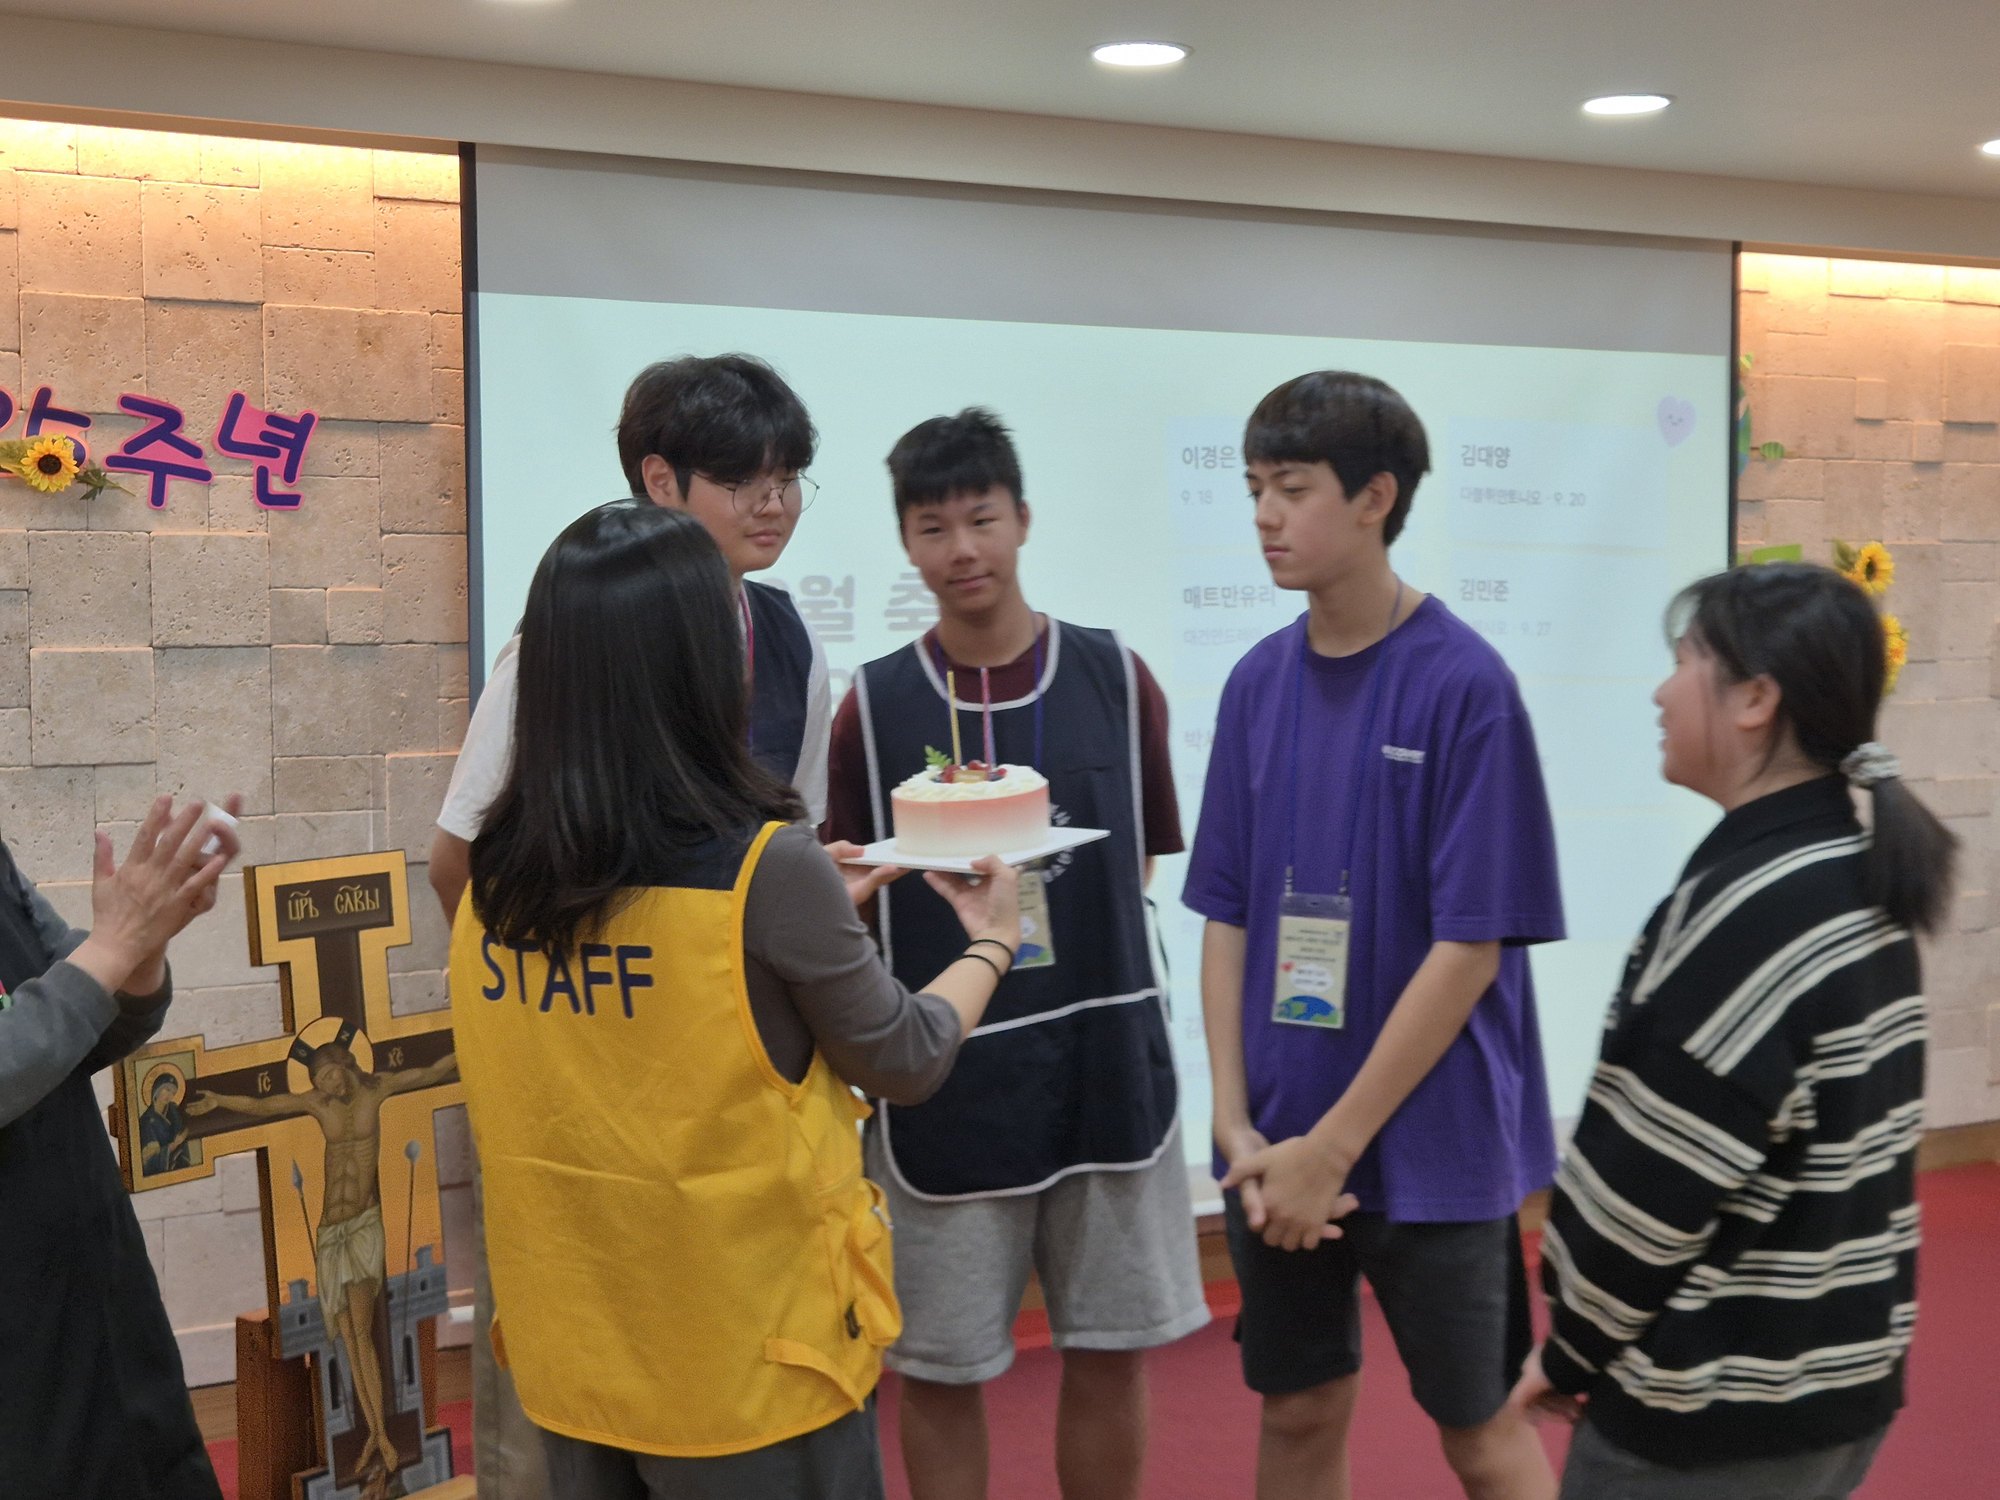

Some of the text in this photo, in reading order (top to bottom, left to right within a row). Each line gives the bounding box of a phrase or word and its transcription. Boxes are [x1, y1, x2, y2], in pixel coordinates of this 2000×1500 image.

[1182, 445, 1237, 469] 이경은
[1460, 444, 1511, 469] 김대양
[1183, 585, 1276, 609] 매트만유리
[1459, 578, 1510, 602] 김민준
[481, 931, 654, 1019] STAFF
